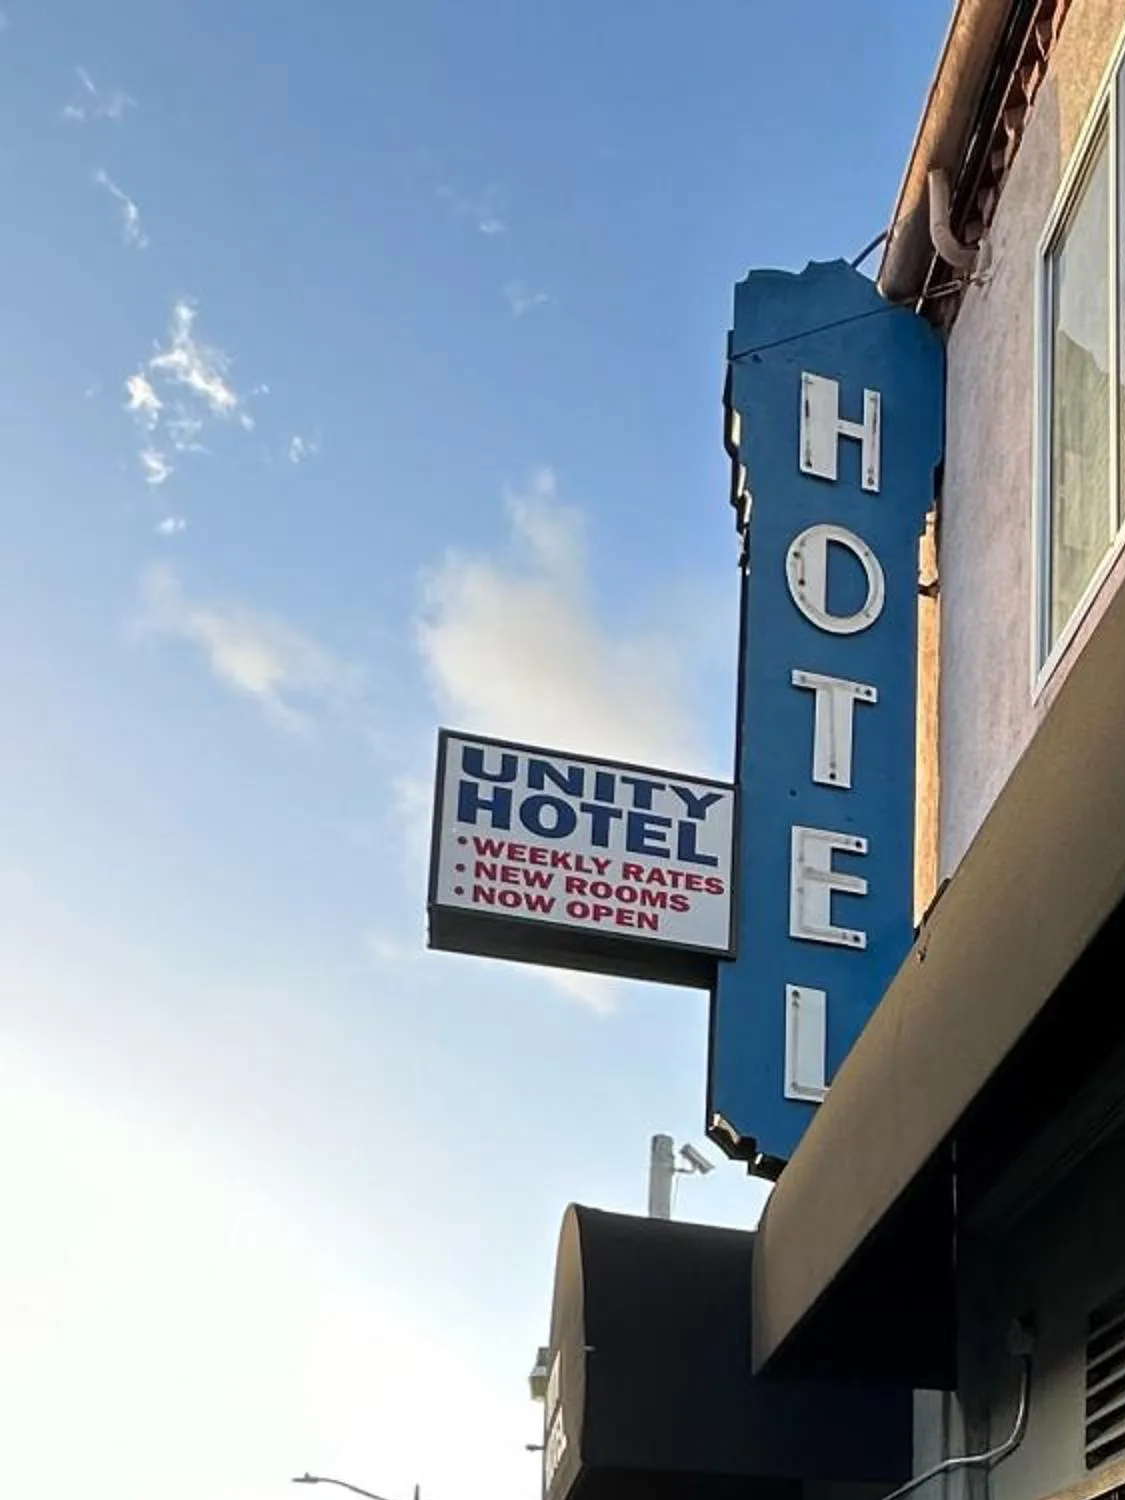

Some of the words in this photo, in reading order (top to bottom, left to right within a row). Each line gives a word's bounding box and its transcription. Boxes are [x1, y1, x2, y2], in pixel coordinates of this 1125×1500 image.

[784, 371, 885, 1103] HOTEL
[460, 745, 724, 821] UNITY
[456, 779, 719, 868] HOTEL
[472, 836, 613, 876] WEEKLY
[621, 862, 725, 895] RATES
[474, 861, 554, 890] NEW
[564, 875, 691, 913] ROOMS
[472, 884, 556, 914] NOW
[565, 900, 660, 931] OPEN
